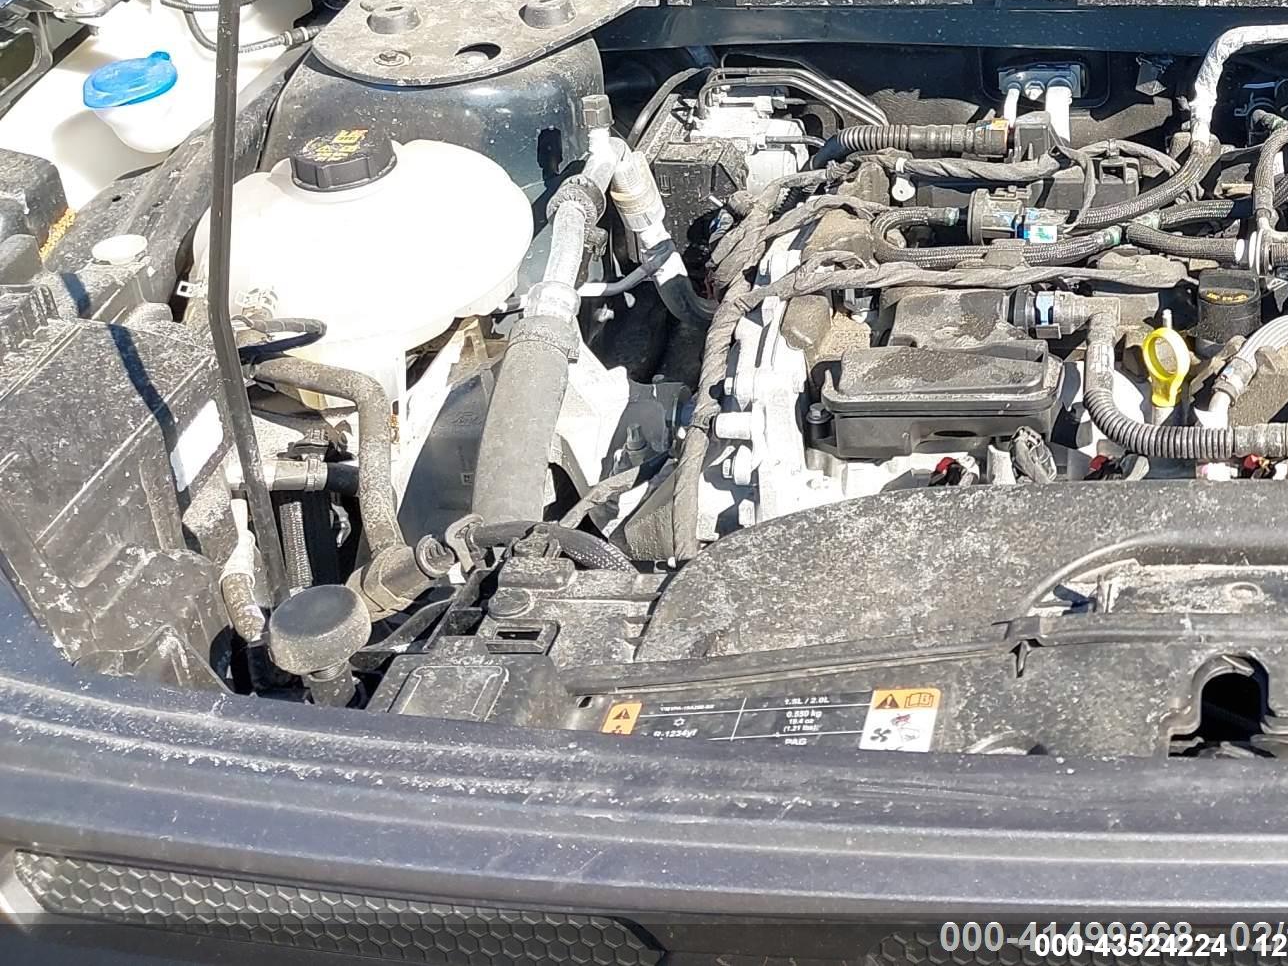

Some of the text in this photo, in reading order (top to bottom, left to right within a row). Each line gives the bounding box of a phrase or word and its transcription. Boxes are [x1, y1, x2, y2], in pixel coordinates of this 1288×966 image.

[810, 696, 830, 704] 2.0L
[810, 709, 822, 720] kg
[784, 737, 807, 746] PAG
